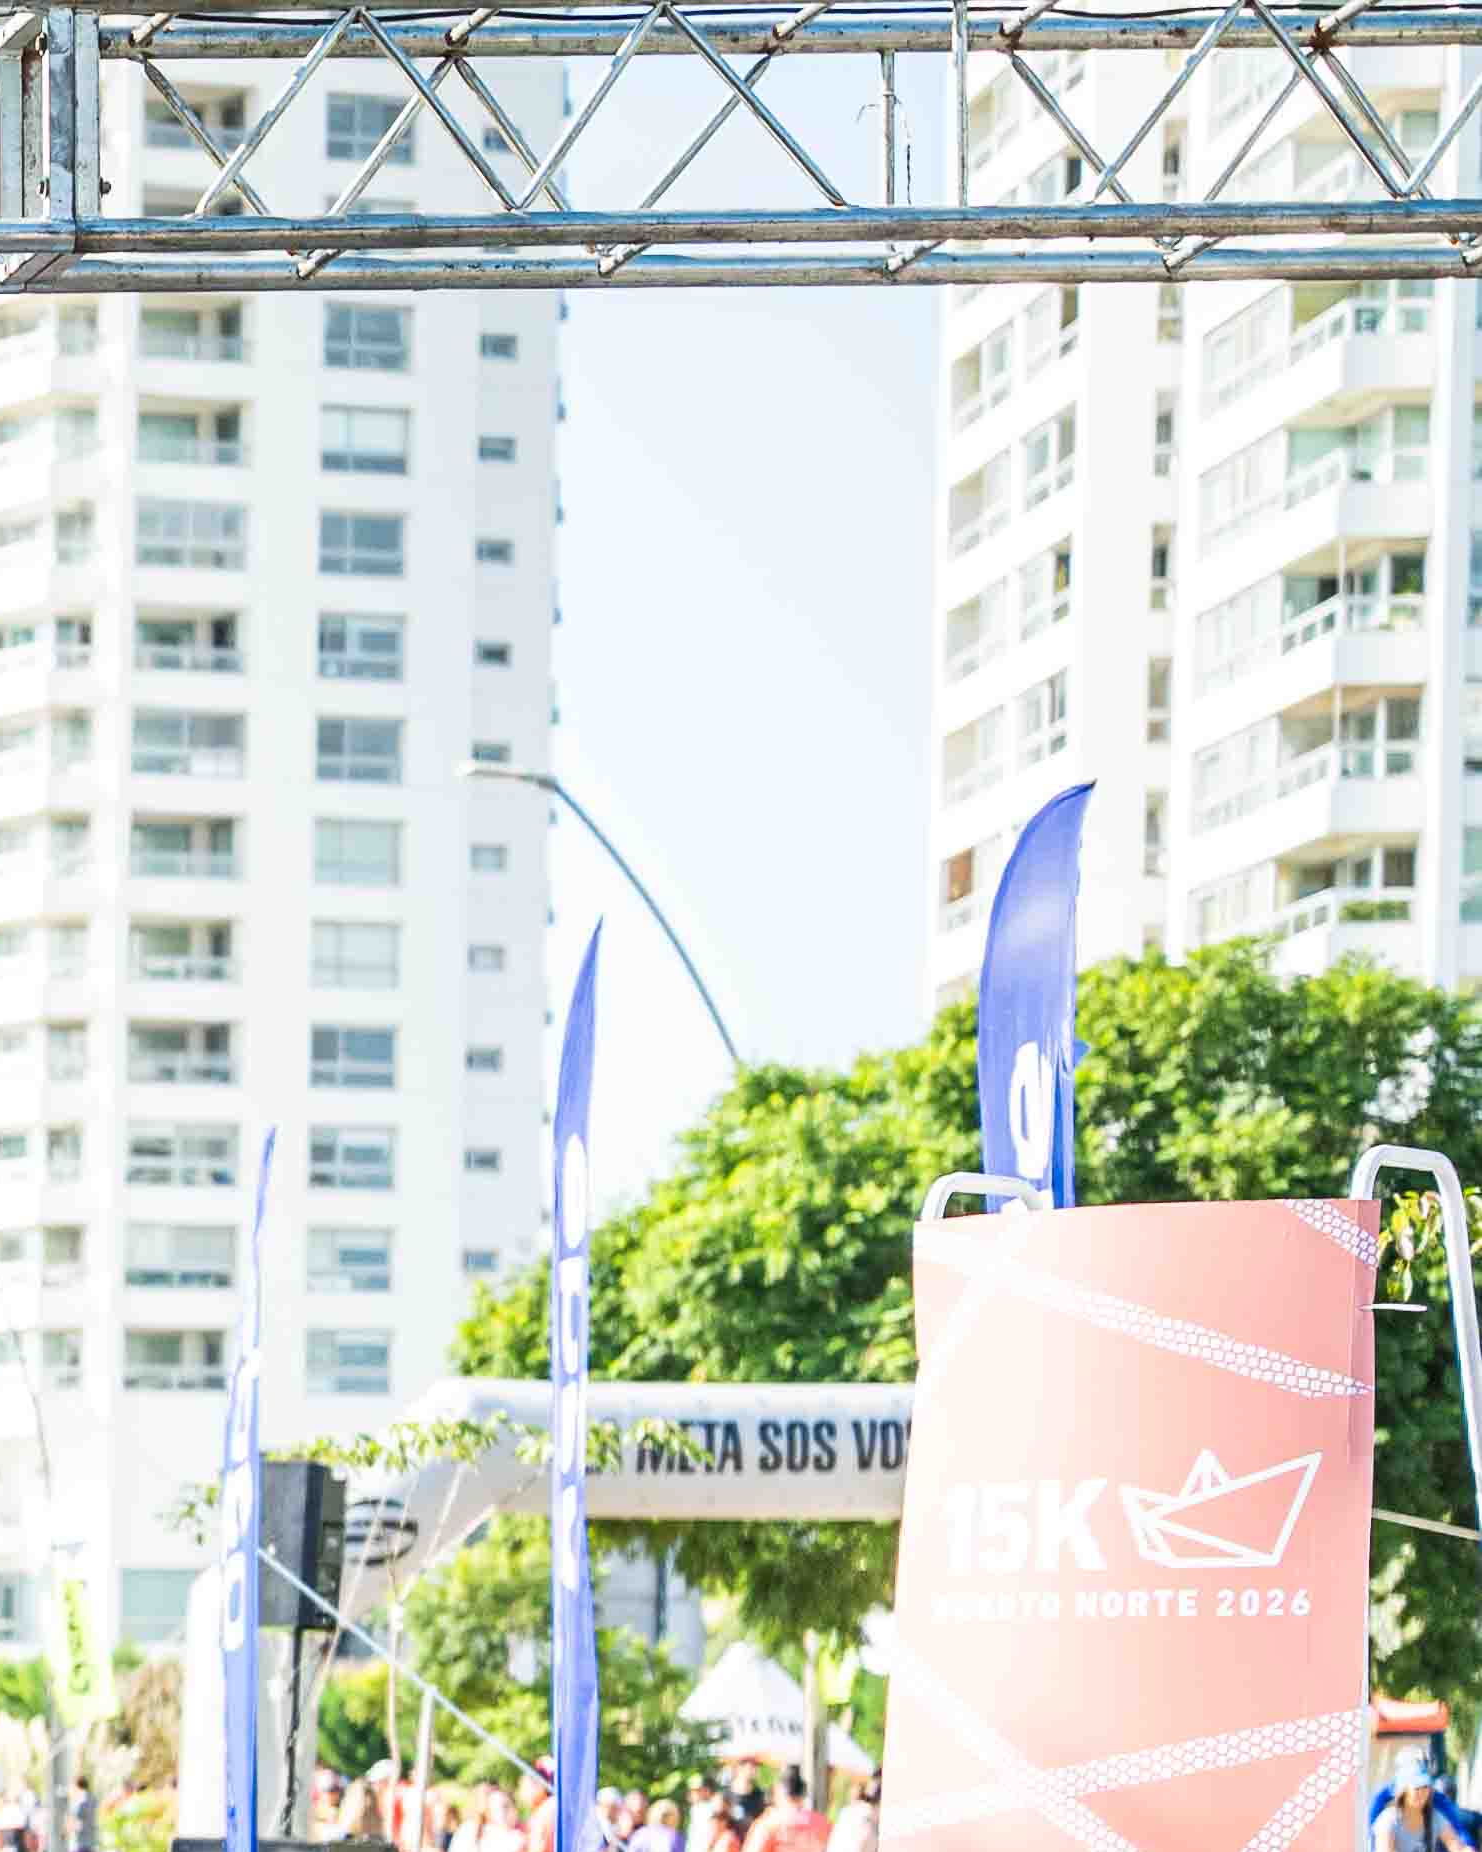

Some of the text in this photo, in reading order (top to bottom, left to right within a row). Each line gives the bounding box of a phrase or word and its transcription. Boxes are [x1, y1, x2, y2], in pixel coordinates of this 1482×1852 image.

[757, 1418, 838, 1474] SOS
[851, 1416, 912, 1473] VO
[1075, 1589, 1198, 1618] NORTE
[1216, 1588, 1312, 1617] 2026
